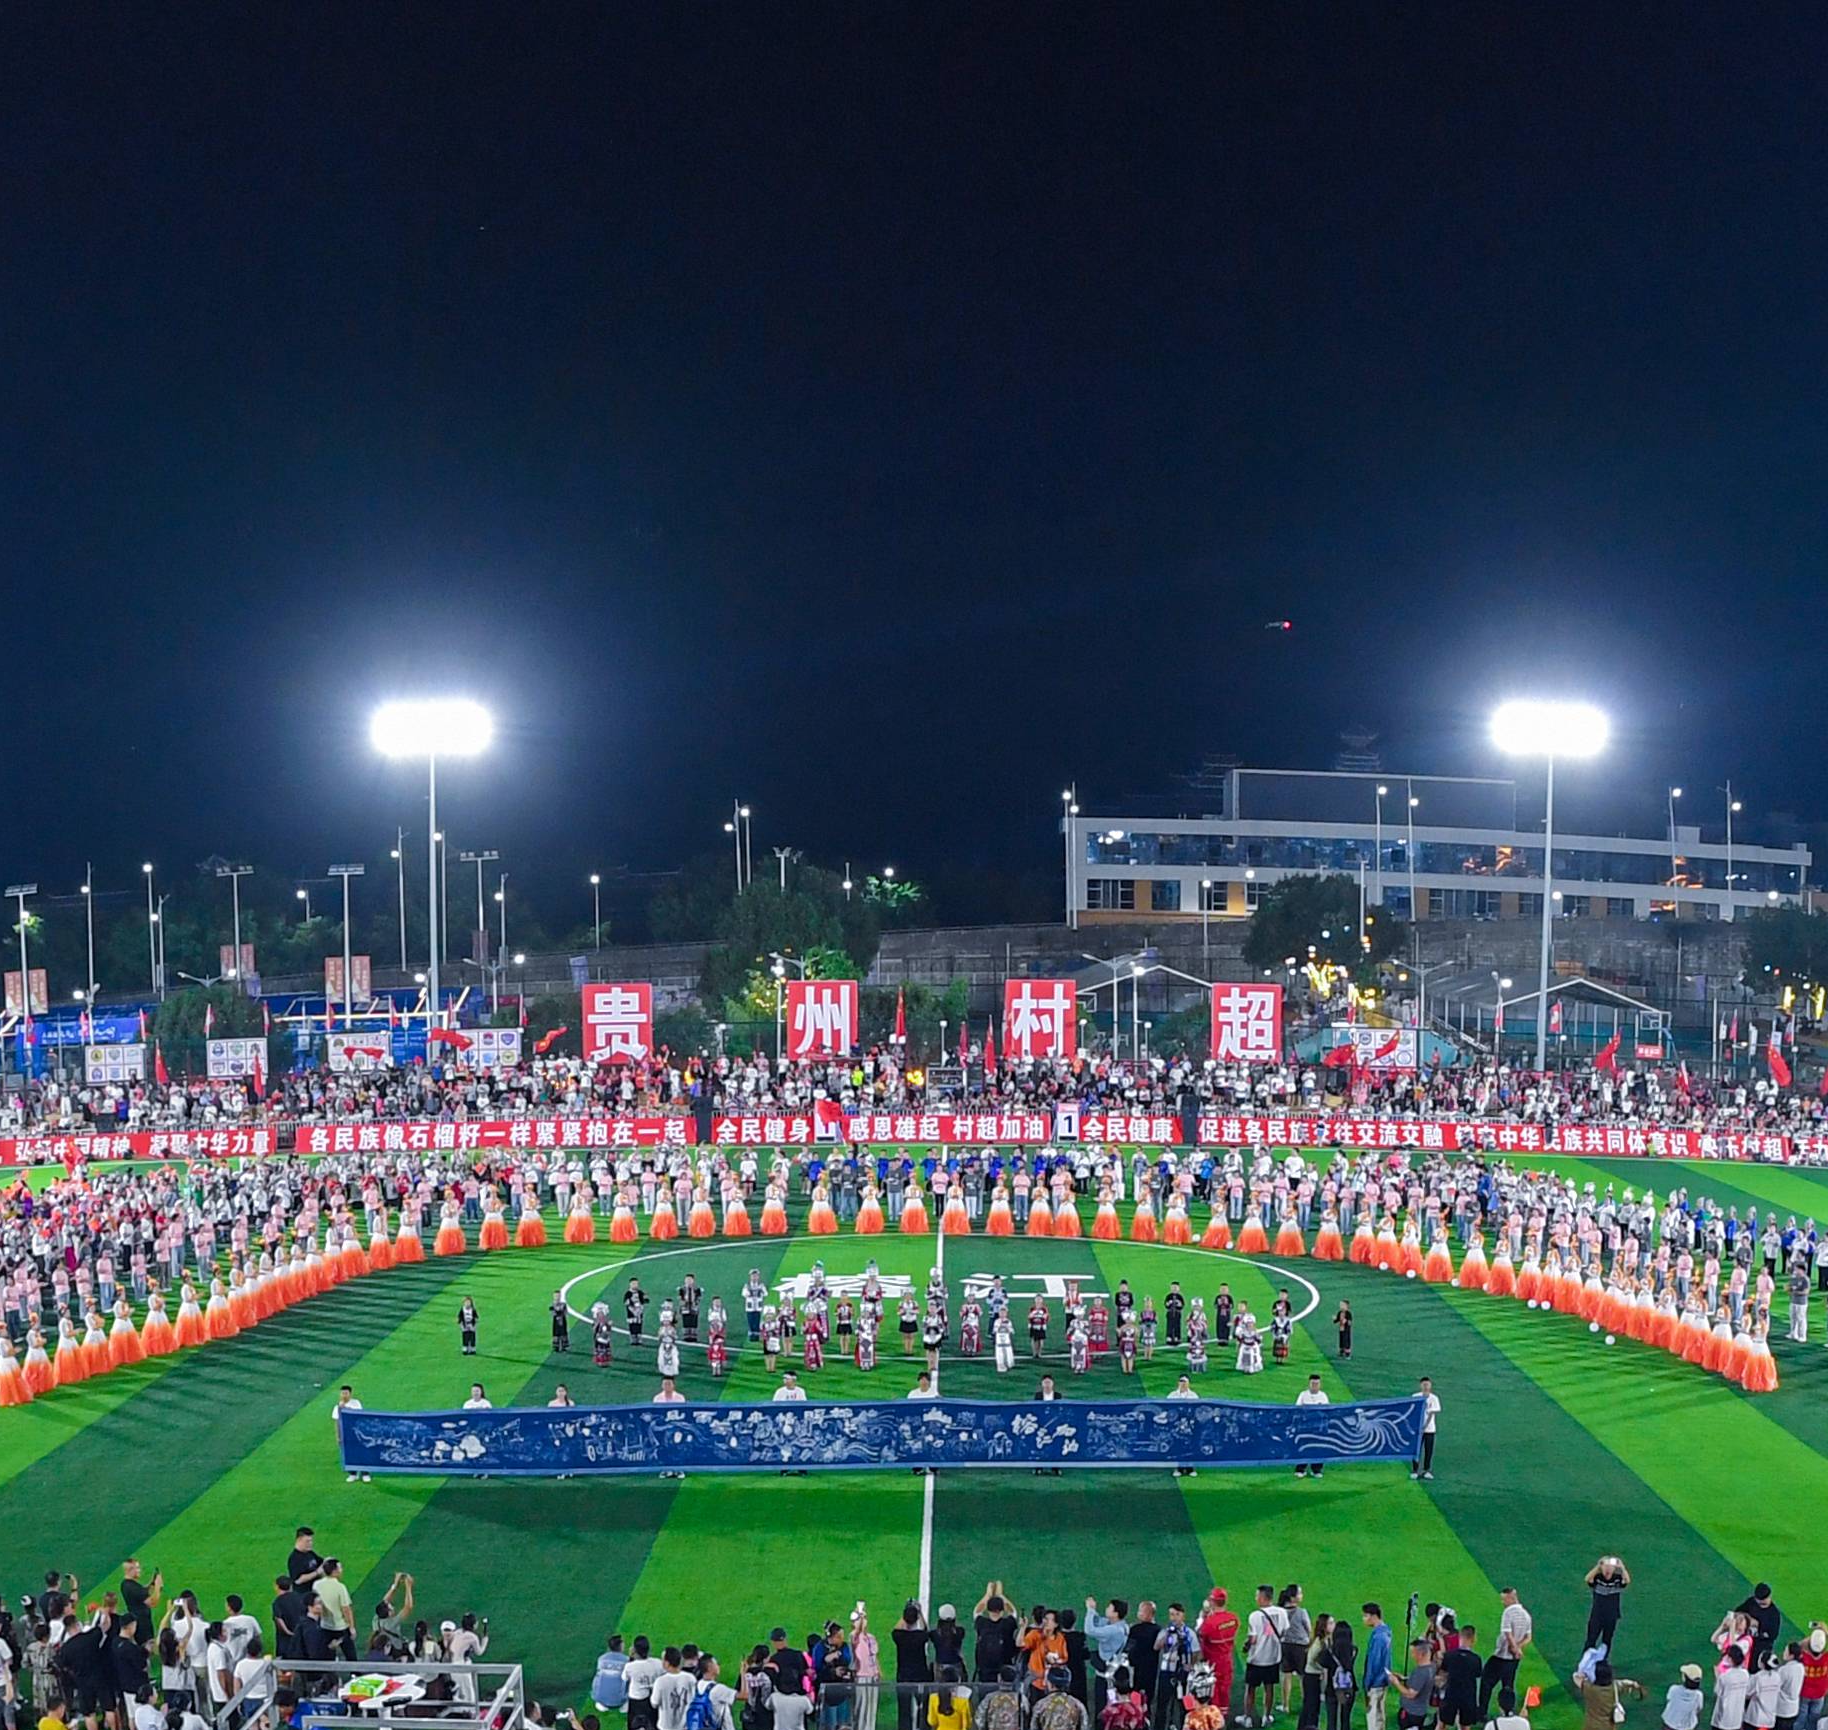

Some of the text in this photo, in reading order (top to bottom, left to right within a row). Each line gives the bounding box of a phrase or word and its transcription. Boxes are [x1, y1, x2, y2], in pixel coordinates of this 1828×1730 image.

[588, 984, 1276, 1060] 贵 州 村 超
[310, 1119, 686, 1150] 各民族像石榴籽一样紧紧抱在一起
[716, 1118, 810, 1143] 全民健身
[849, 1115, 1045, 1142] 感恩雄起 村超加油
[1082, 1117, 1173, 1142] 全民健康
